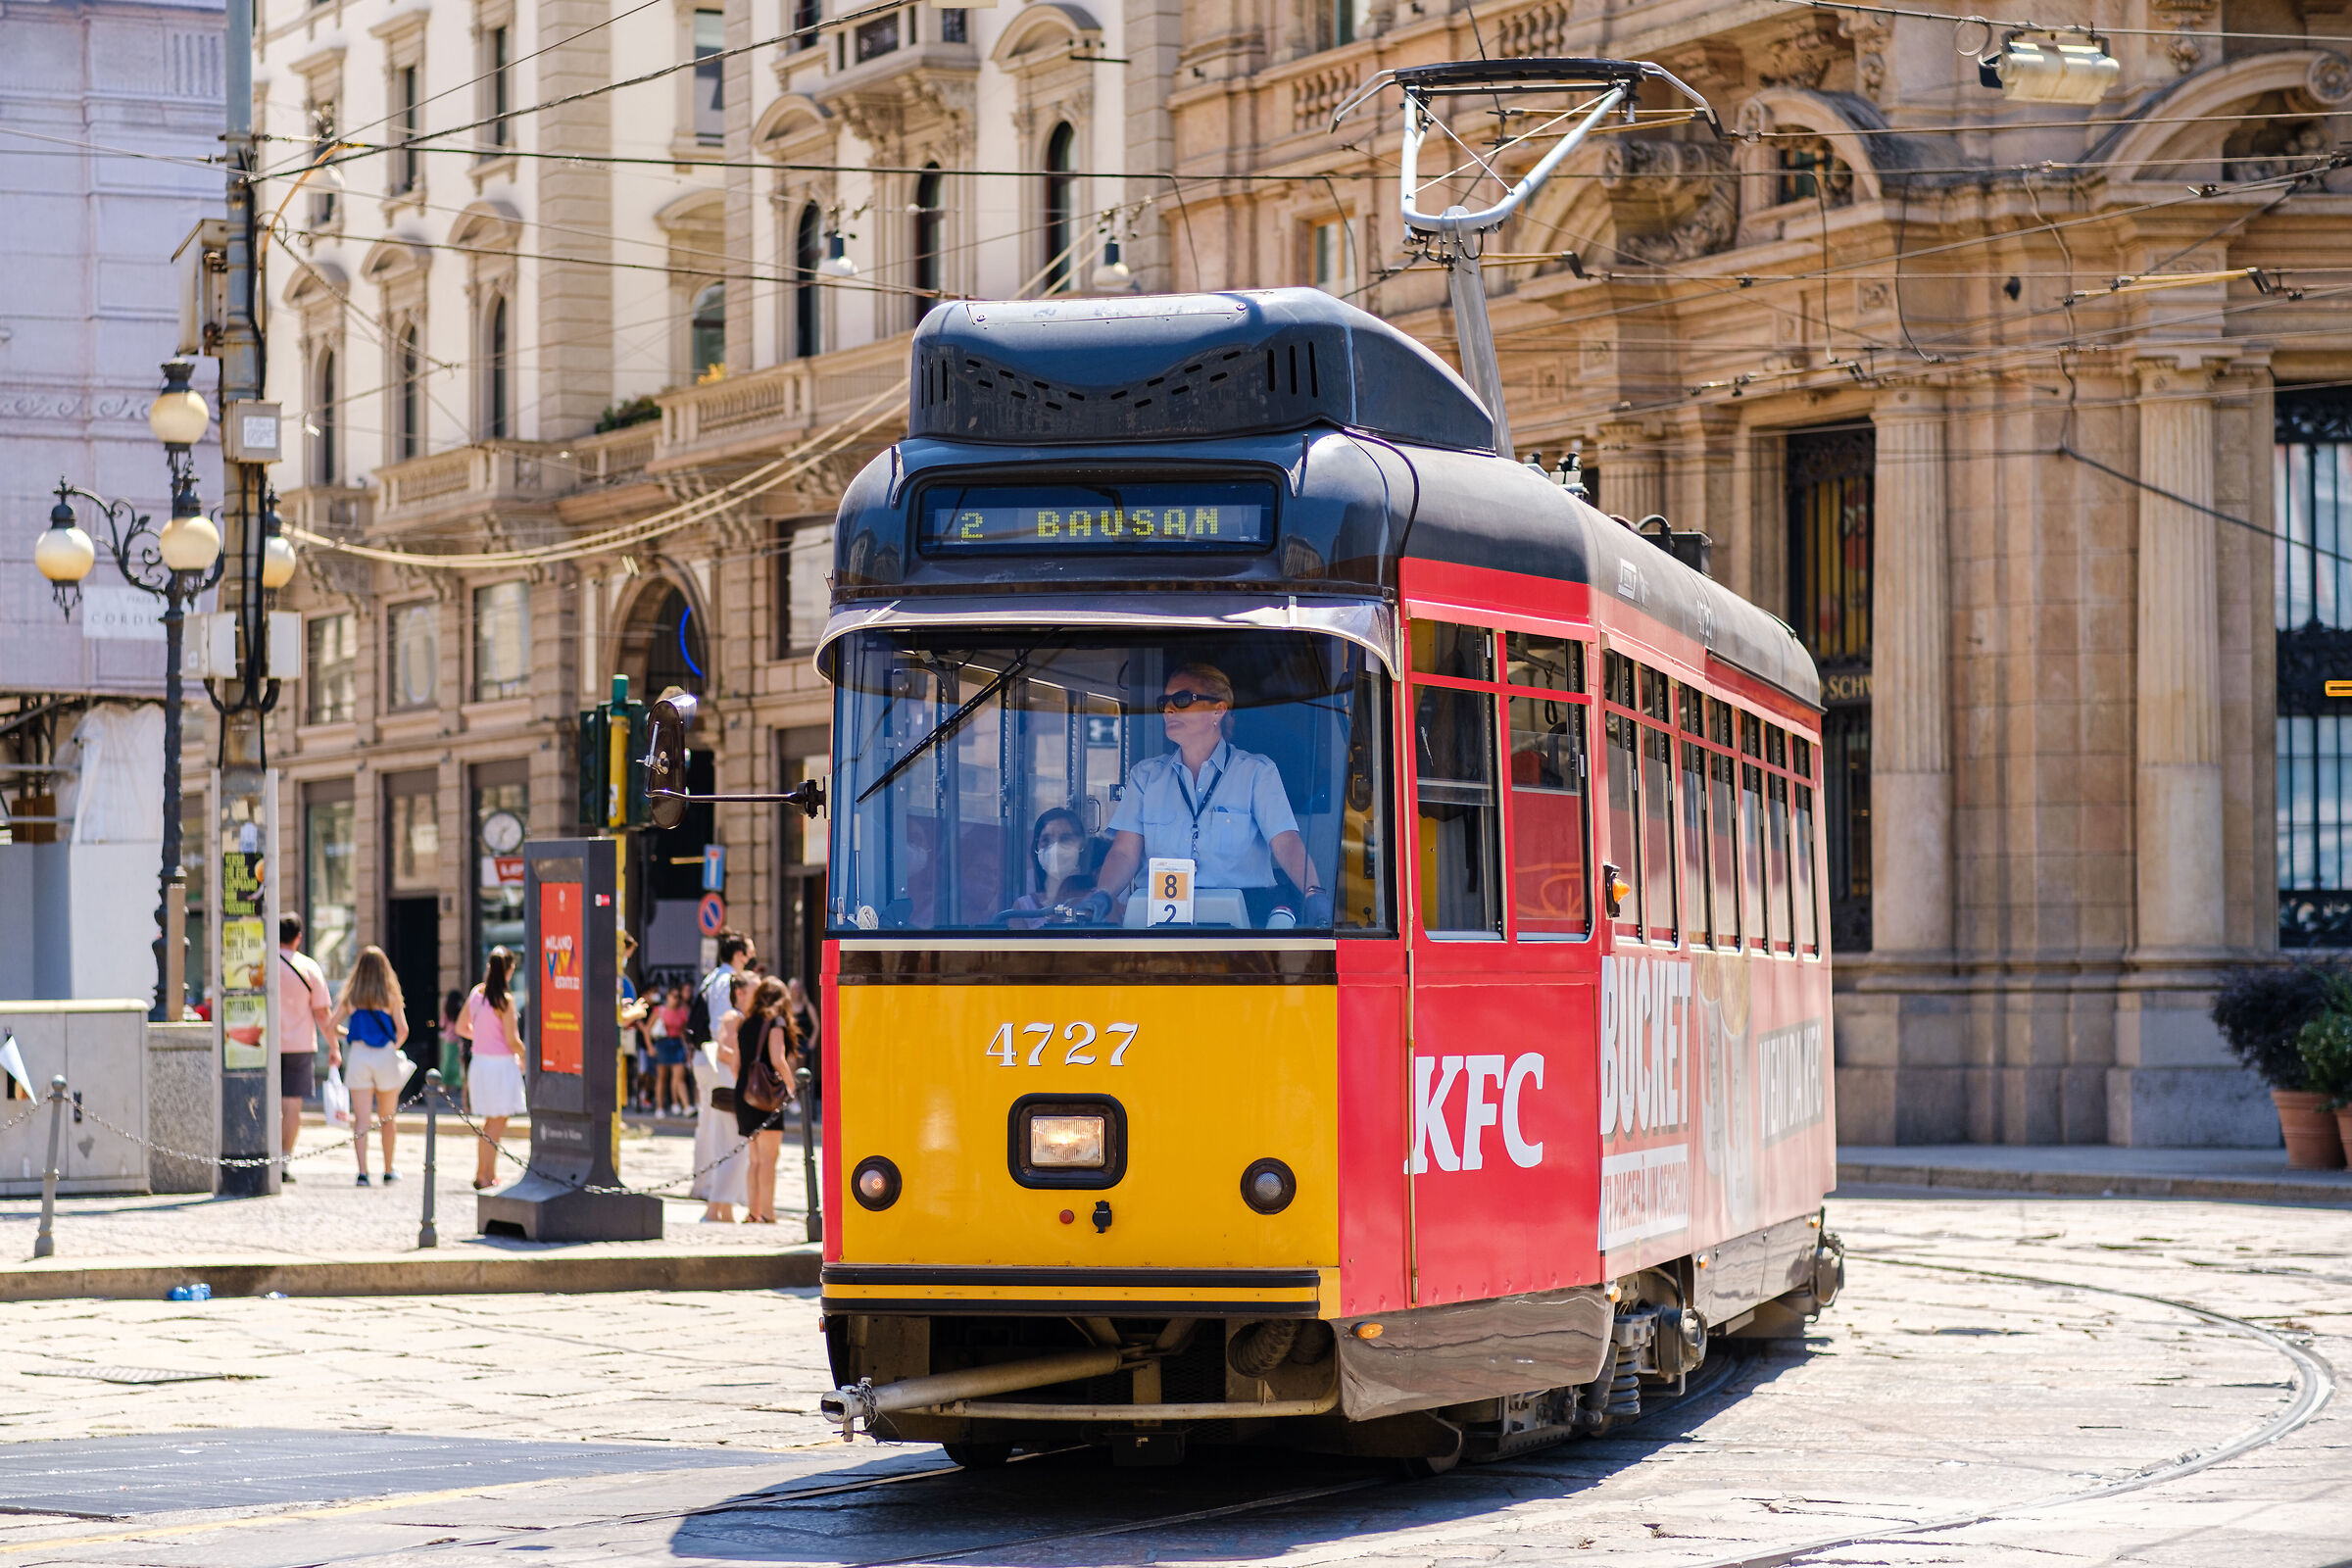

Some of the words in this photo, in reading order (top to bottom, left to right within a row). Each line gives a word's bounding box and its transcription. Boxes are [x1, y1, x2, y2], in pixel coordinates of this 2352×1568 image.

[960, 512, 984, 539] 2
[1037, 508, 1218, 537] BAUSAN
[1164, 874, 1178, 899] 8
[1163, 904, 1177, 923] 2
[986, 1021, 1140, 1067] 4727
[1600, 956, 1691, 1137] BUCKET
[1403, 1052, 1544, 1174] KFC
